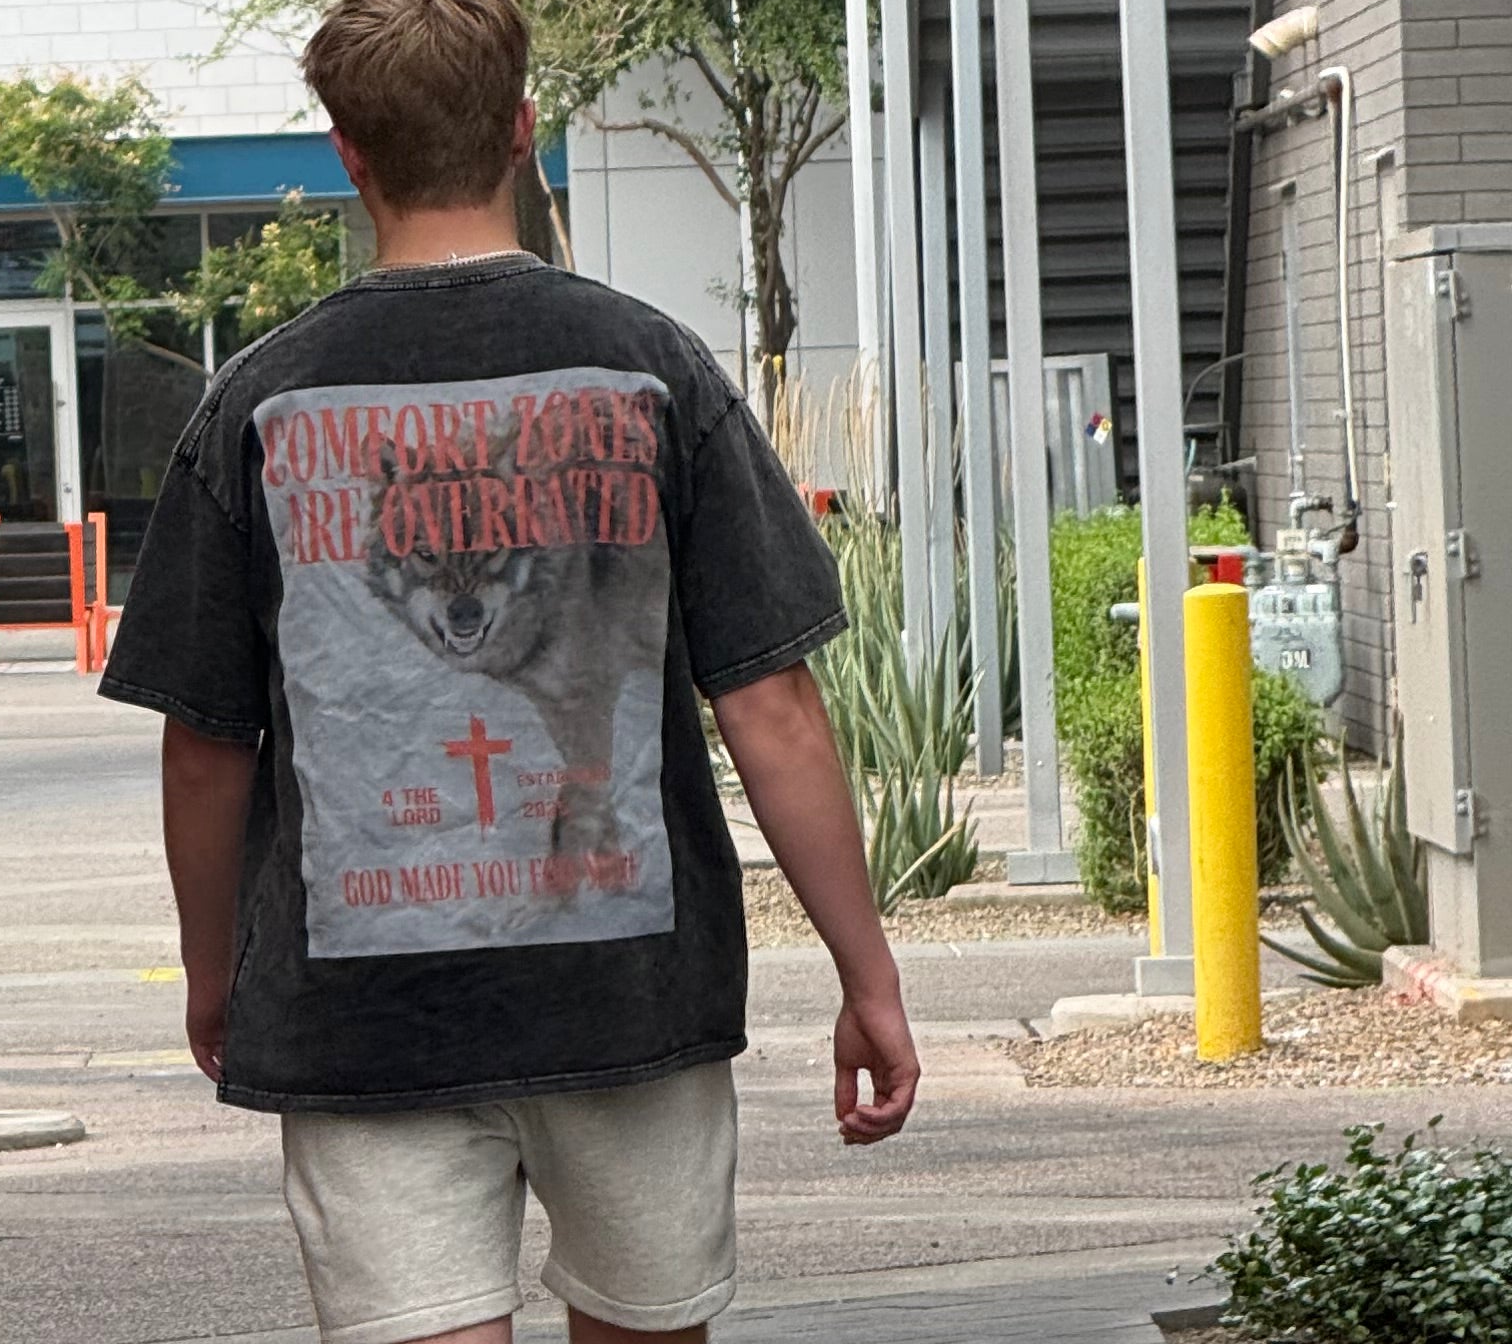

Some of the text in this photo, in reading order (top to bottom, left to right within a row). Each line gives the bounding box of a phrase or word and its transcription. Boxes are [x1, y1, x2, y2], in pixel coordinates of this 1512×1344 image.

[263, 387, 658, 487] COMFORT ZONES
[288, 467, 659, 565] ARE OVERRATED
[391, 808, 441, 827] LORD
[402, 787, 439, 805] THE
[343, 868, 393, 908] GOD
[399, 861, 465, 904] MADE
[471, 858, 522, 898] YOU
